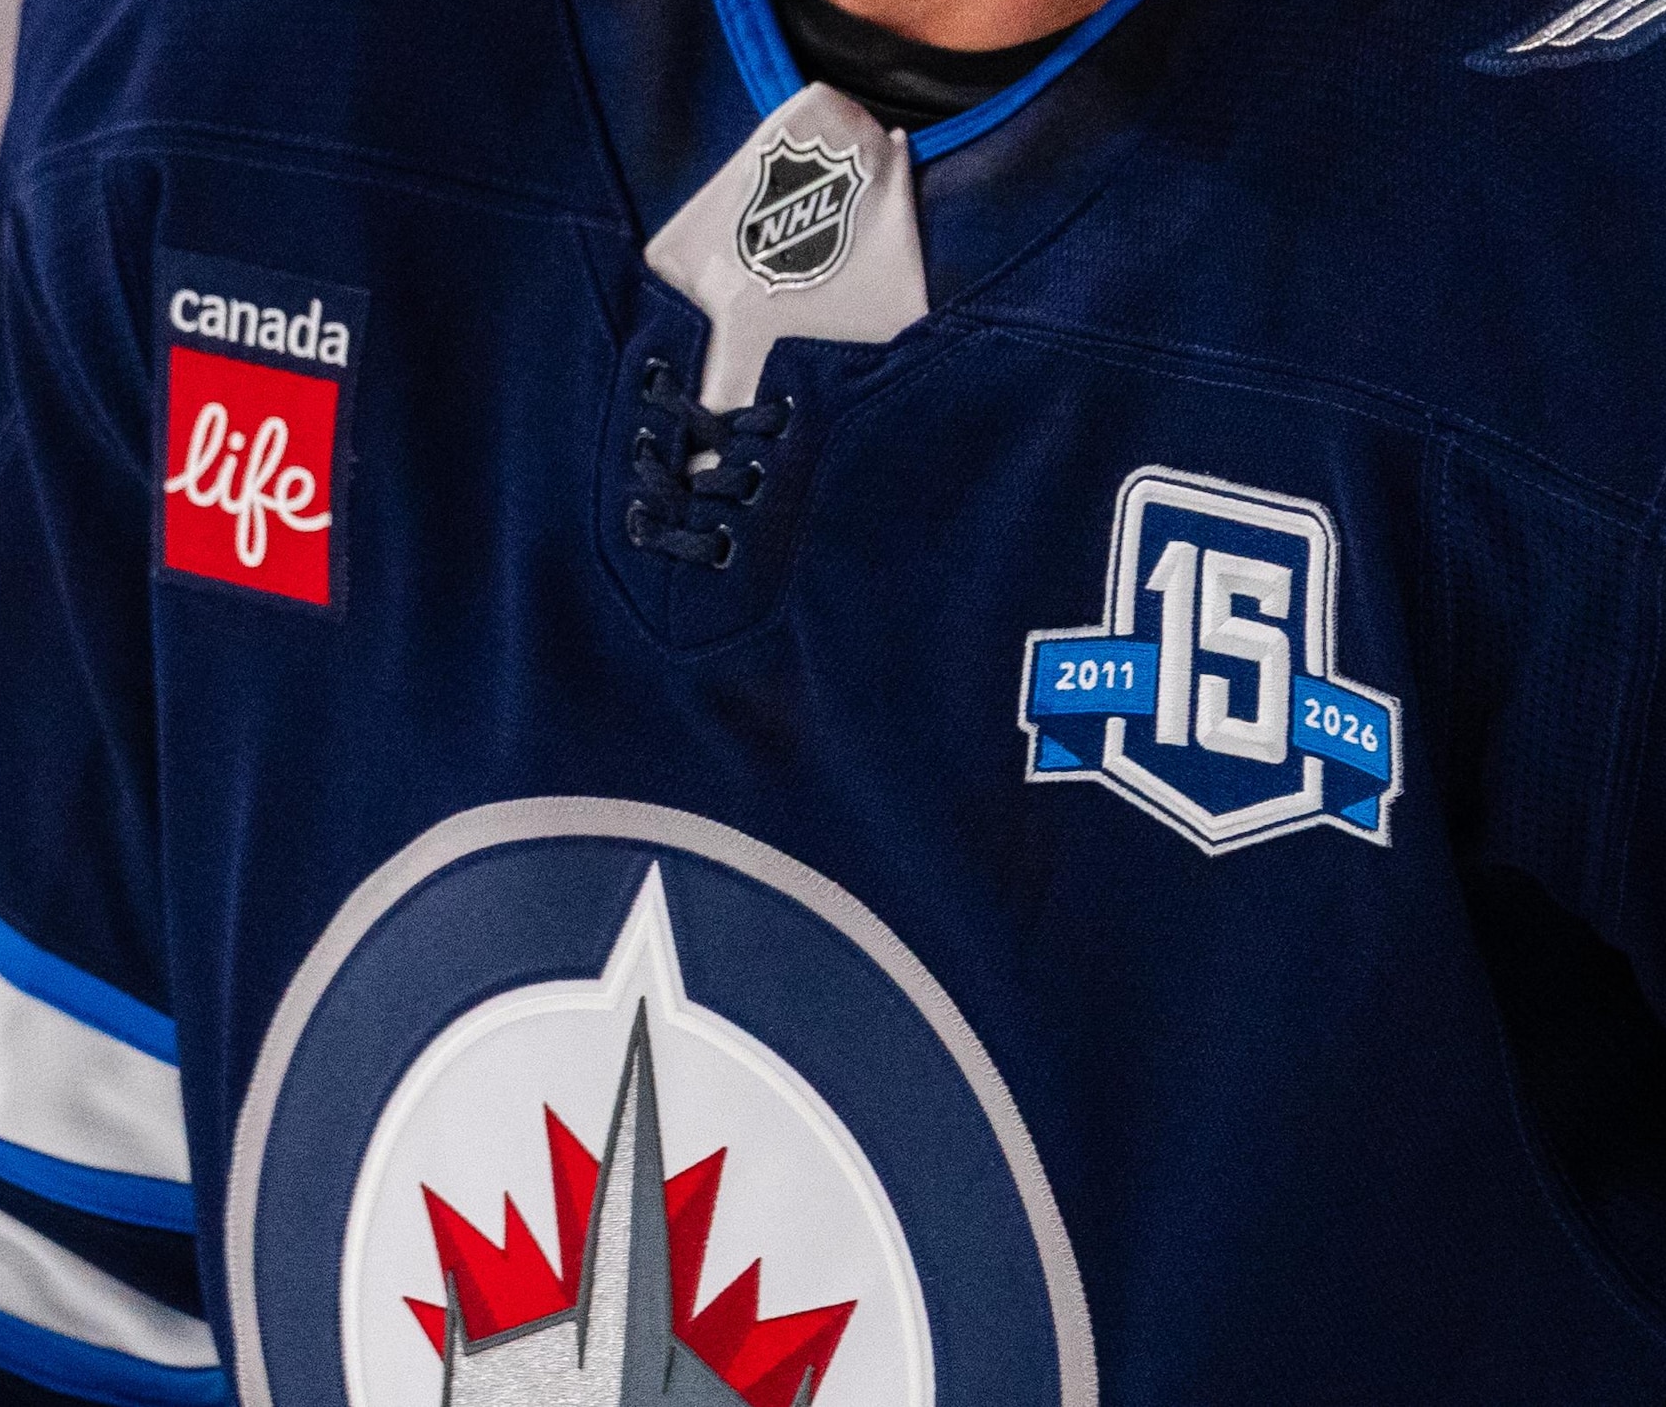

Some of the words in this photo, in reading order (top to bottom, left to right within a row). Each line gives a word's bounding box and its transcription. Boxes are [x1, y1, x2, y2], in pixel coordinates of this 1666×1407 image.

[757, 187, 841, 252] NHL
[169, 288, 350, 368] canada
[164, 401, 333, 568] life
[1054, 659, 1134, 691] 2011
[1145, 540, 1293, 765] 15
[1304, 698, 1380, 753] 2026
